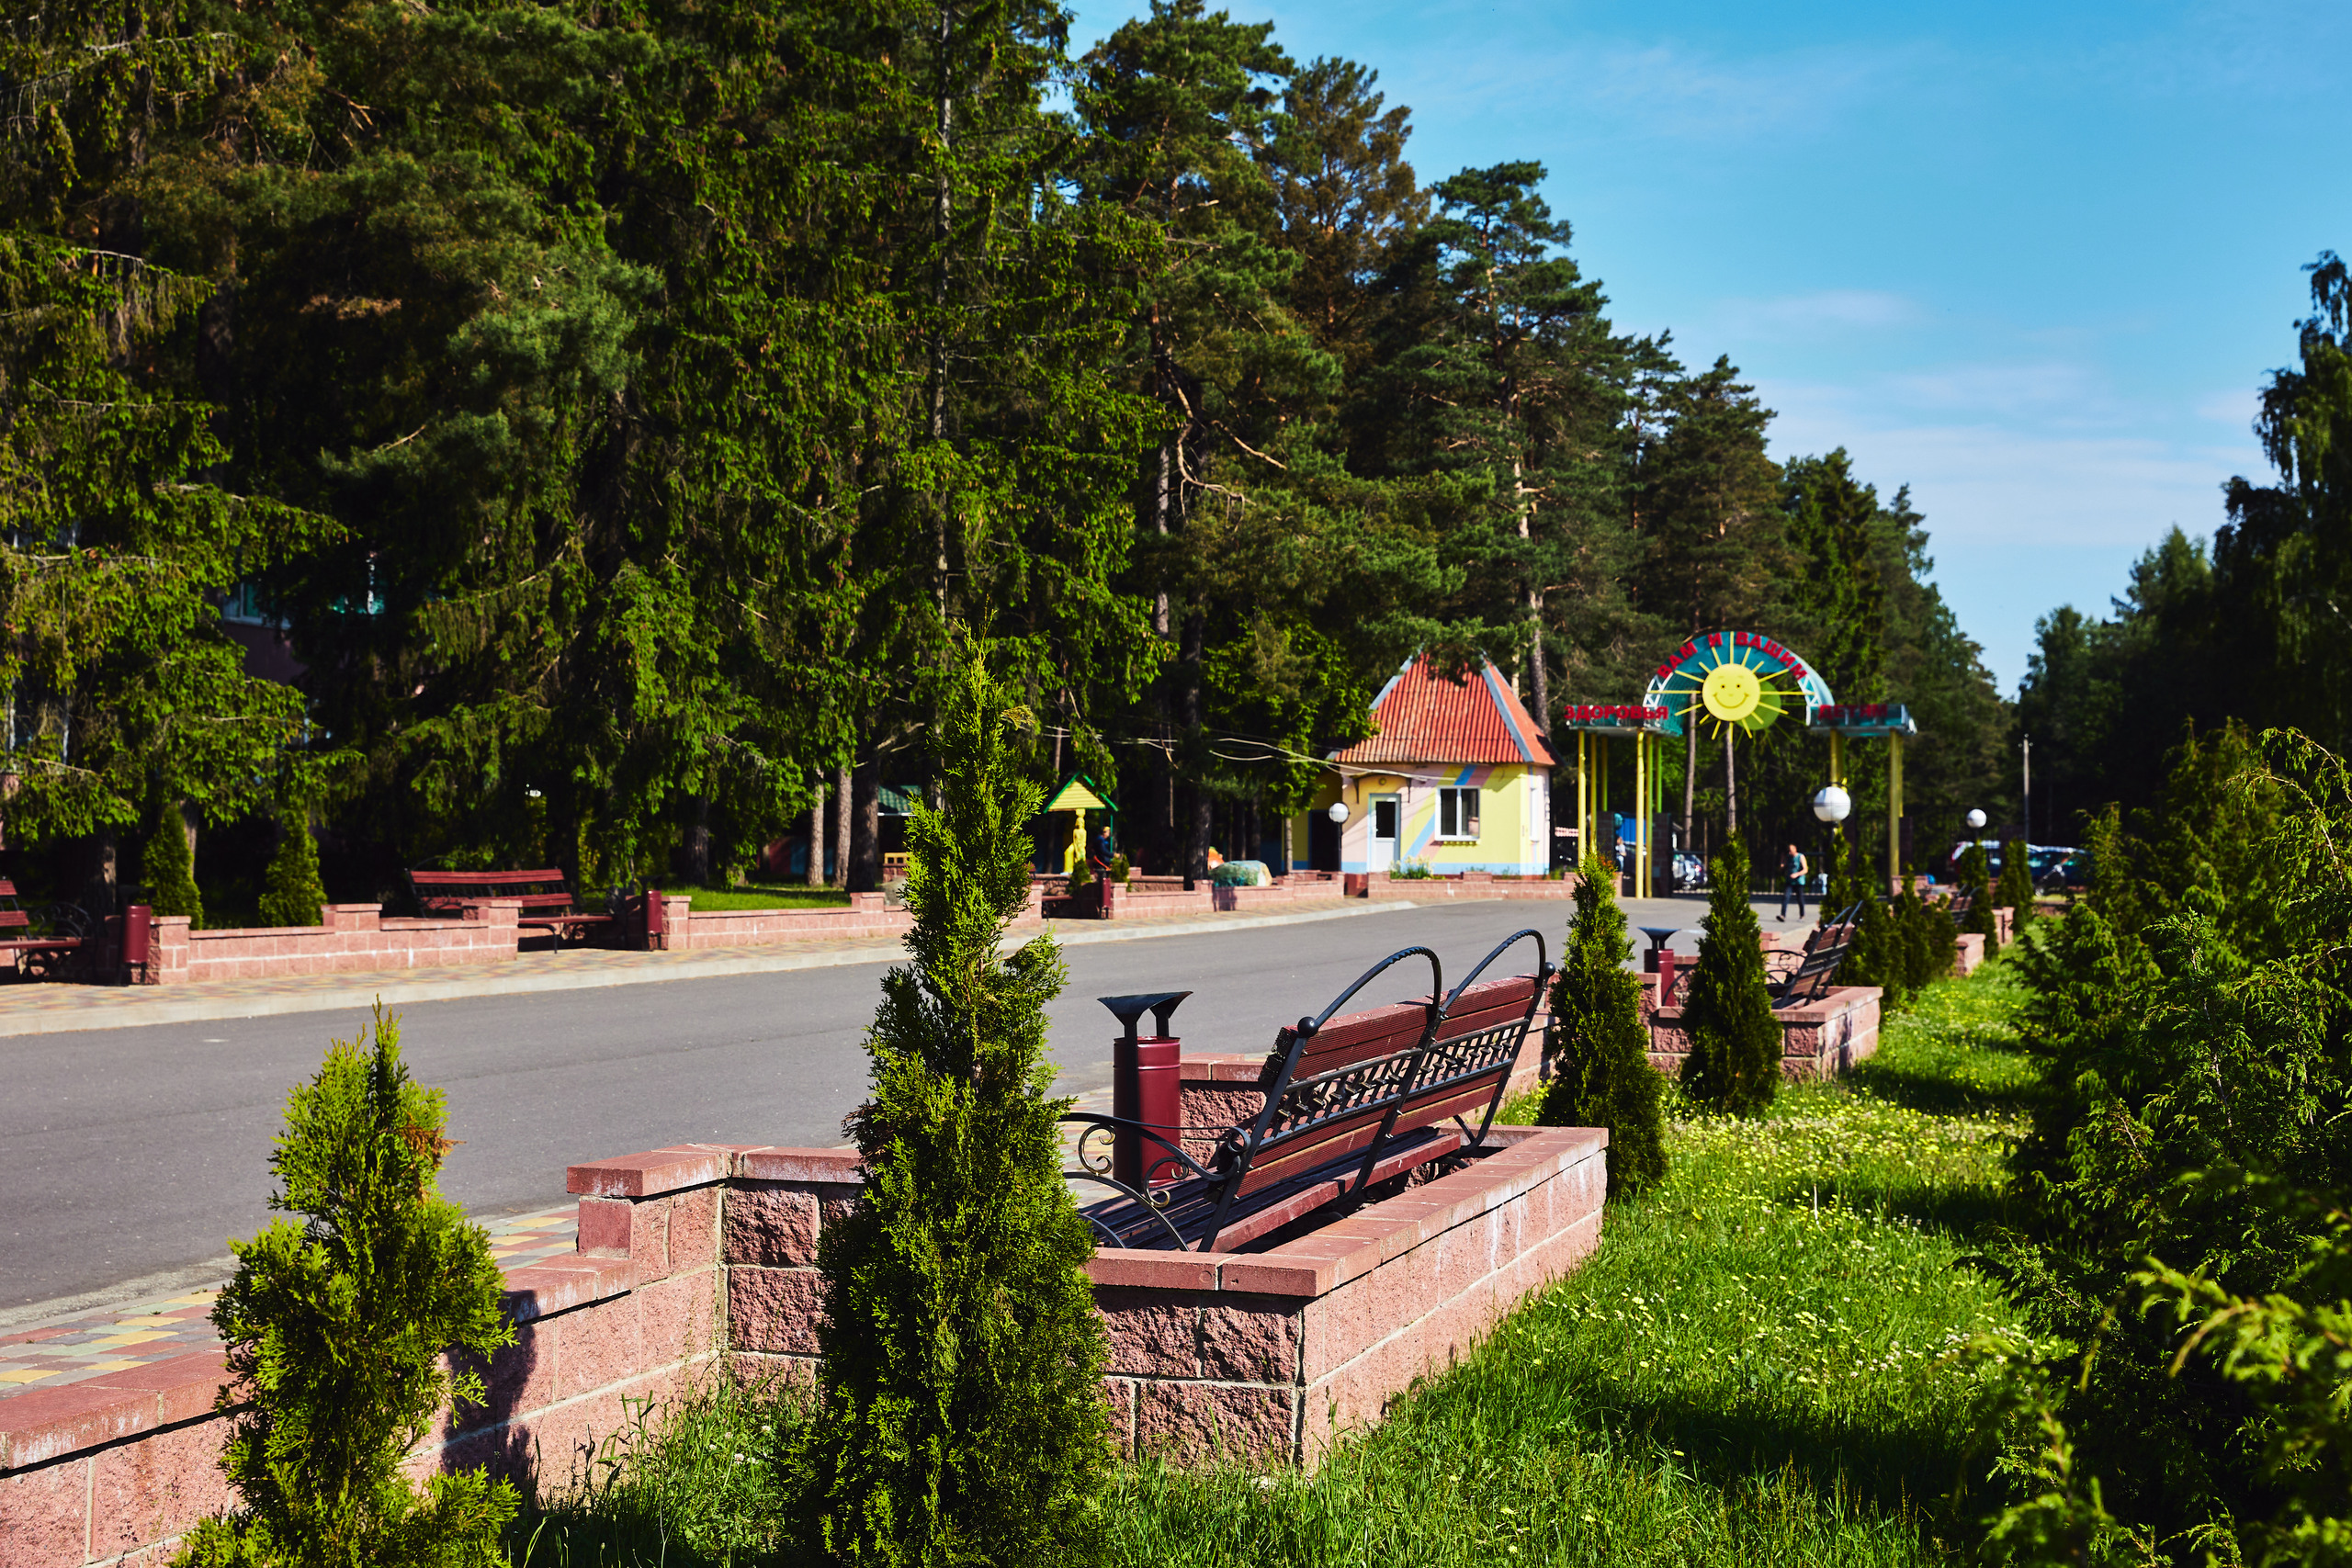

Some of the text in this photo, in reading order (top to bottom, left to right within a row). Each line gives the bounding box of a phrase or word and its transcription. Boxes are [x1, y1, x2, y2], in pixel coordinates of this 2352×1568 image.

[1657, 631, 1807, 680] ВАМ И ВАШИМ
[1564, 705, 1668, 721] ЗДОРОВЬЯ
[1818, 705, 1887, 720] ДЕТЯМ
